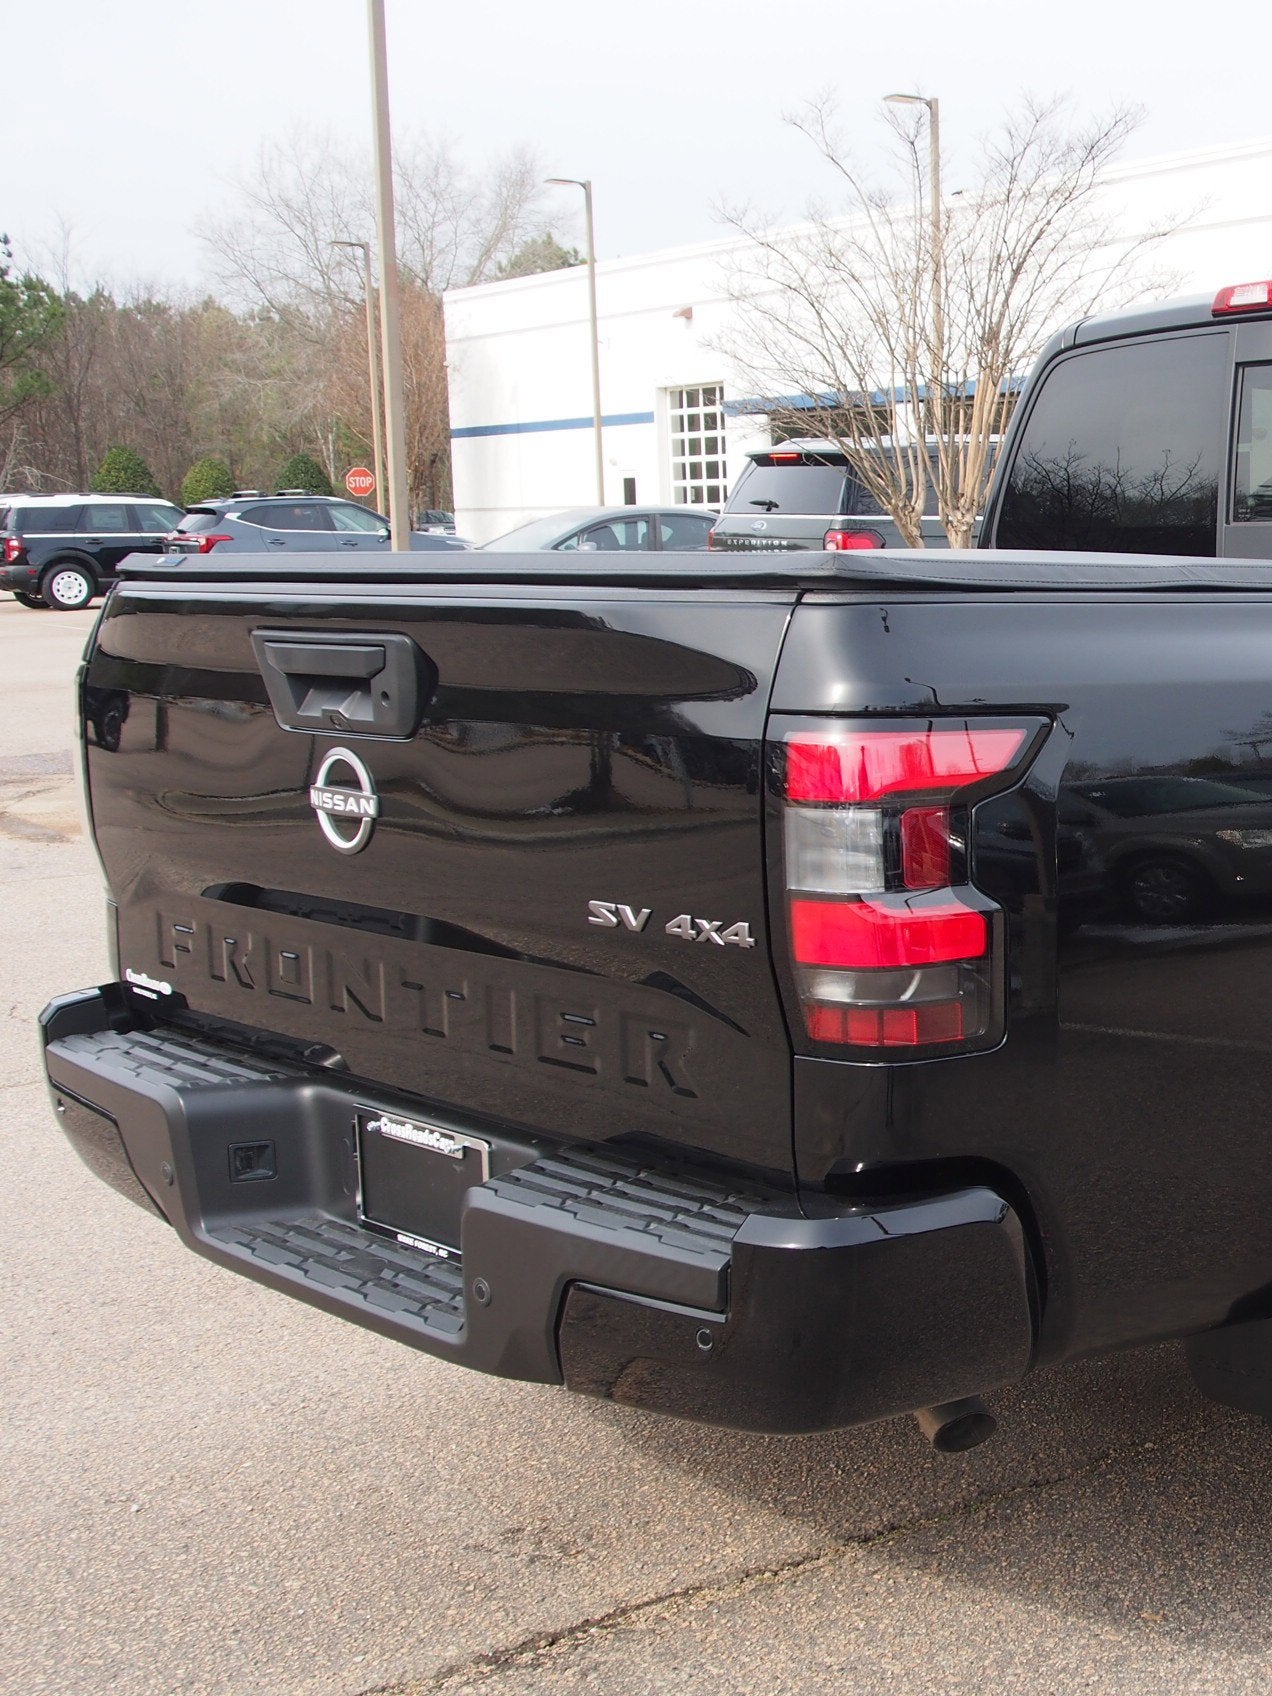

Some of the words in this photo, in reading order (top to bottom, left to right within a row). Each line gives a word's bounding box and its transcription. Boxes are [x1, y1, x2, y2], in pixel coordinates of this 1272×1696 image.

[349, 476, 373, 488] STOP
[310, 789, 376, 815] NISSAN
[588, 900, 652, 933] SV
[155, 909, 702, 1099] FRONTIER
